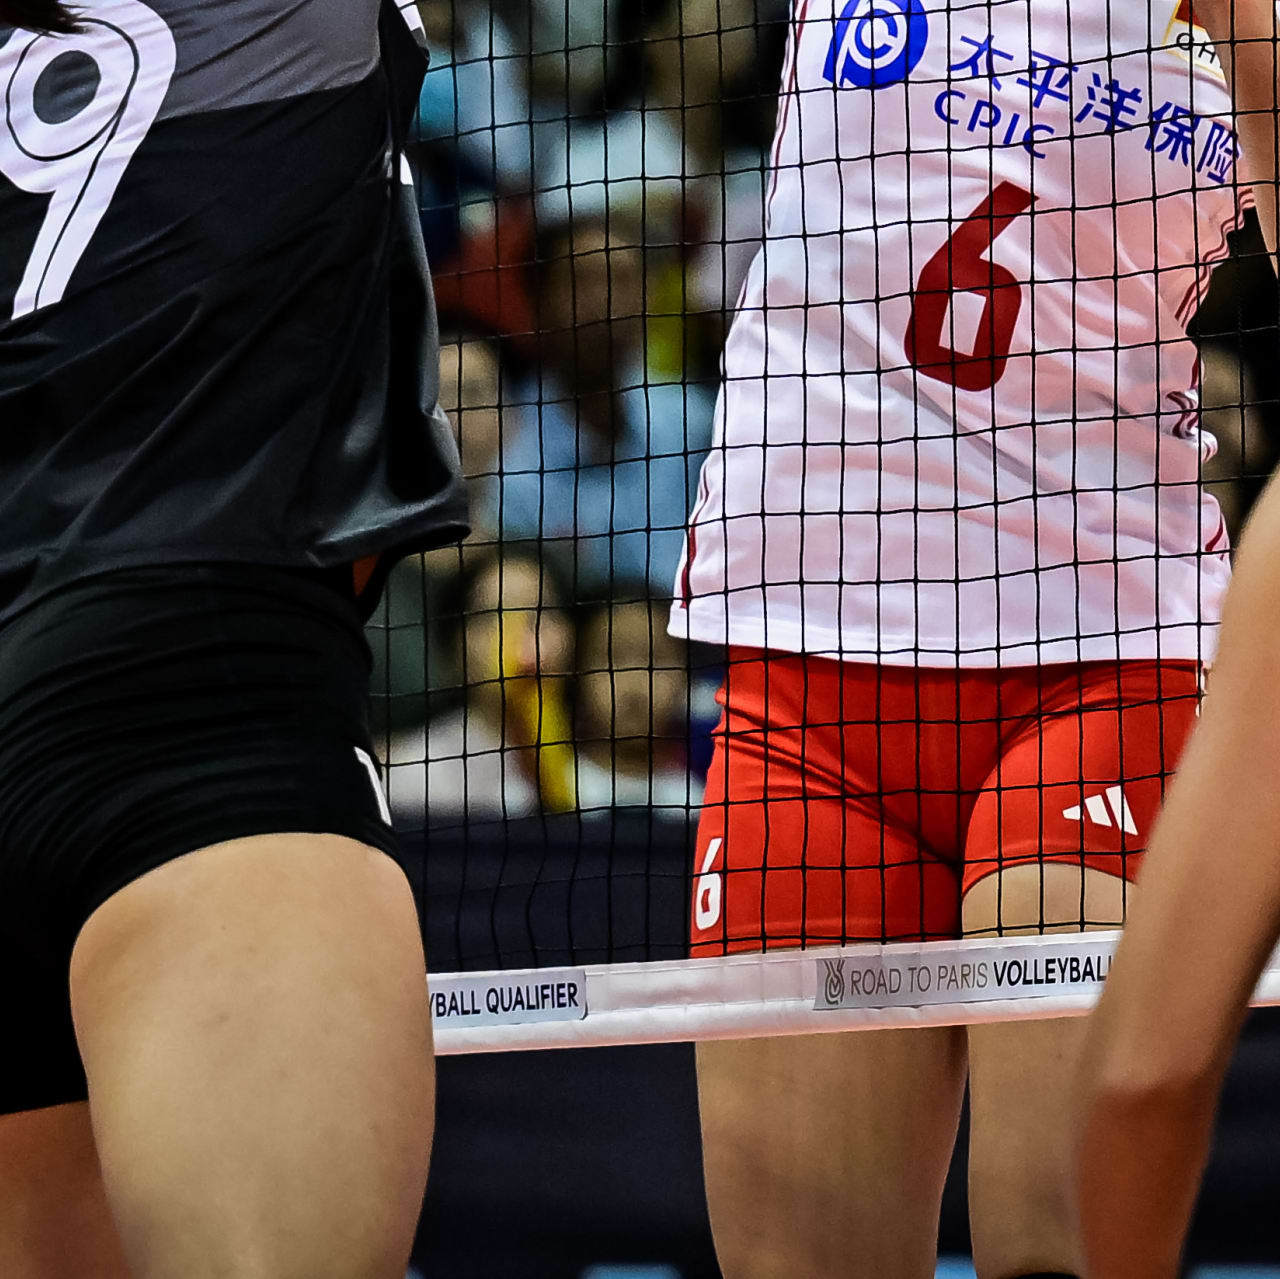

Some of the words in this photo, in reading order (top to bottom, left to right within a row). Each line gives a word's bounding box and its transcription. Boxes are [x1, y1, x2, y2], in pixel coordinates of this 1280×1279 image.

[934, 90, 1056, 159] CPIC
[950, 34, 1240, 184] 太平洋保险
[904, 181, 1039, 392] 6
[696, 837, 722, 930] 6
[486, 982, 579, 1015] QUALIFIER
[850, 969, 901, 996] ROAD
[908, 966, 932, 993] TO
[937, 962, 988, 991] PARIS
